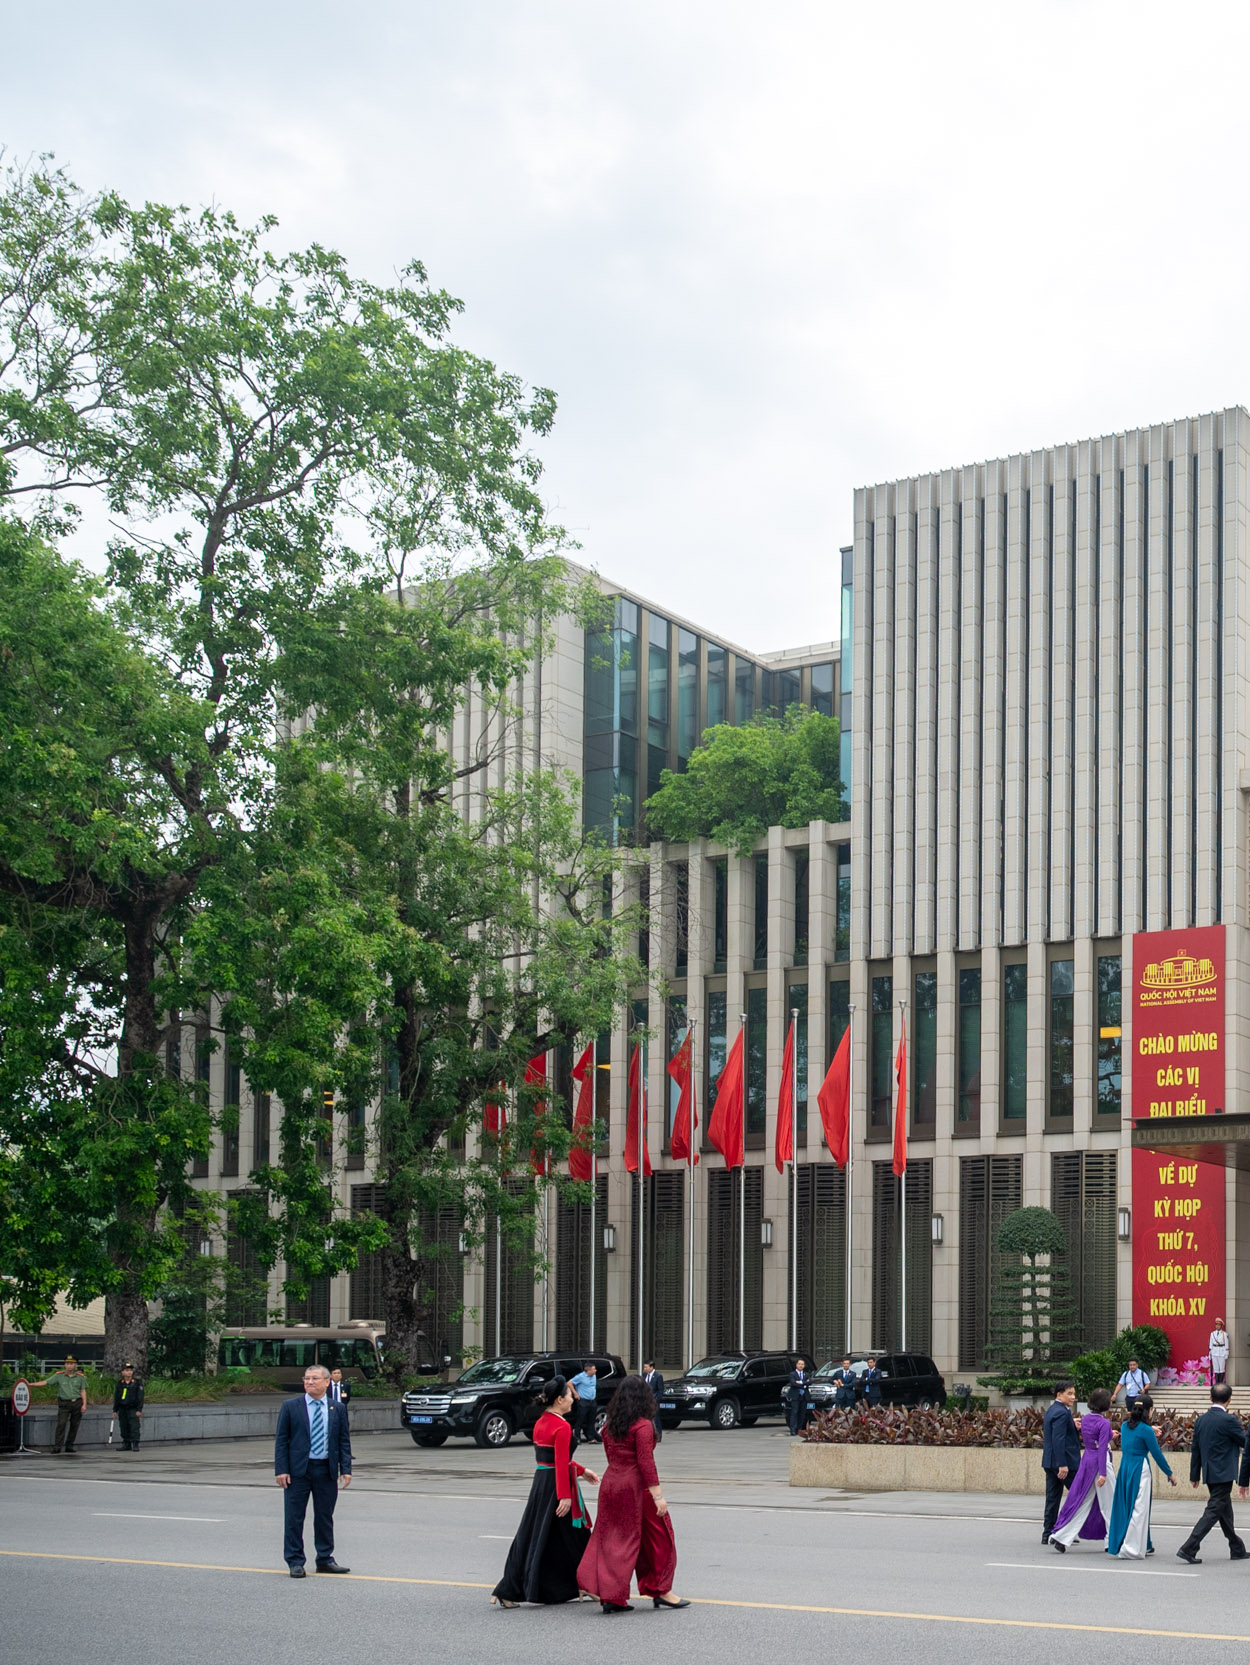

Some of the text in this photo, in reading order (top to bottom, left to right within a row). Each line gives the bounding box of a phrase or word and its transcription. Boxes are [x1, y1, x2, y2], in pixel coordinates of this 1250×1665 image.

[1140, 987, 1216, 1000] QUỐC HỘI VIỆT NAM
[1139, 1031, 1218, 1055] CHÀO MỪNG
[1156, 1064, 1199, 1088] CÁC VỊ
[1176, 1093, 1206, 1116] BIỂU
[1159, 1161, 1198, 1187] VỀ DỰ
[1154, 1196, 1201, 1220] KỲ HỌP
[1157, 1229, 1198, 1251] THỨ 7,
[1147, 1259, 1208, 1286] QUỐC HỘI
[1150, 1295, 1206, 1316] KHÓA XV
